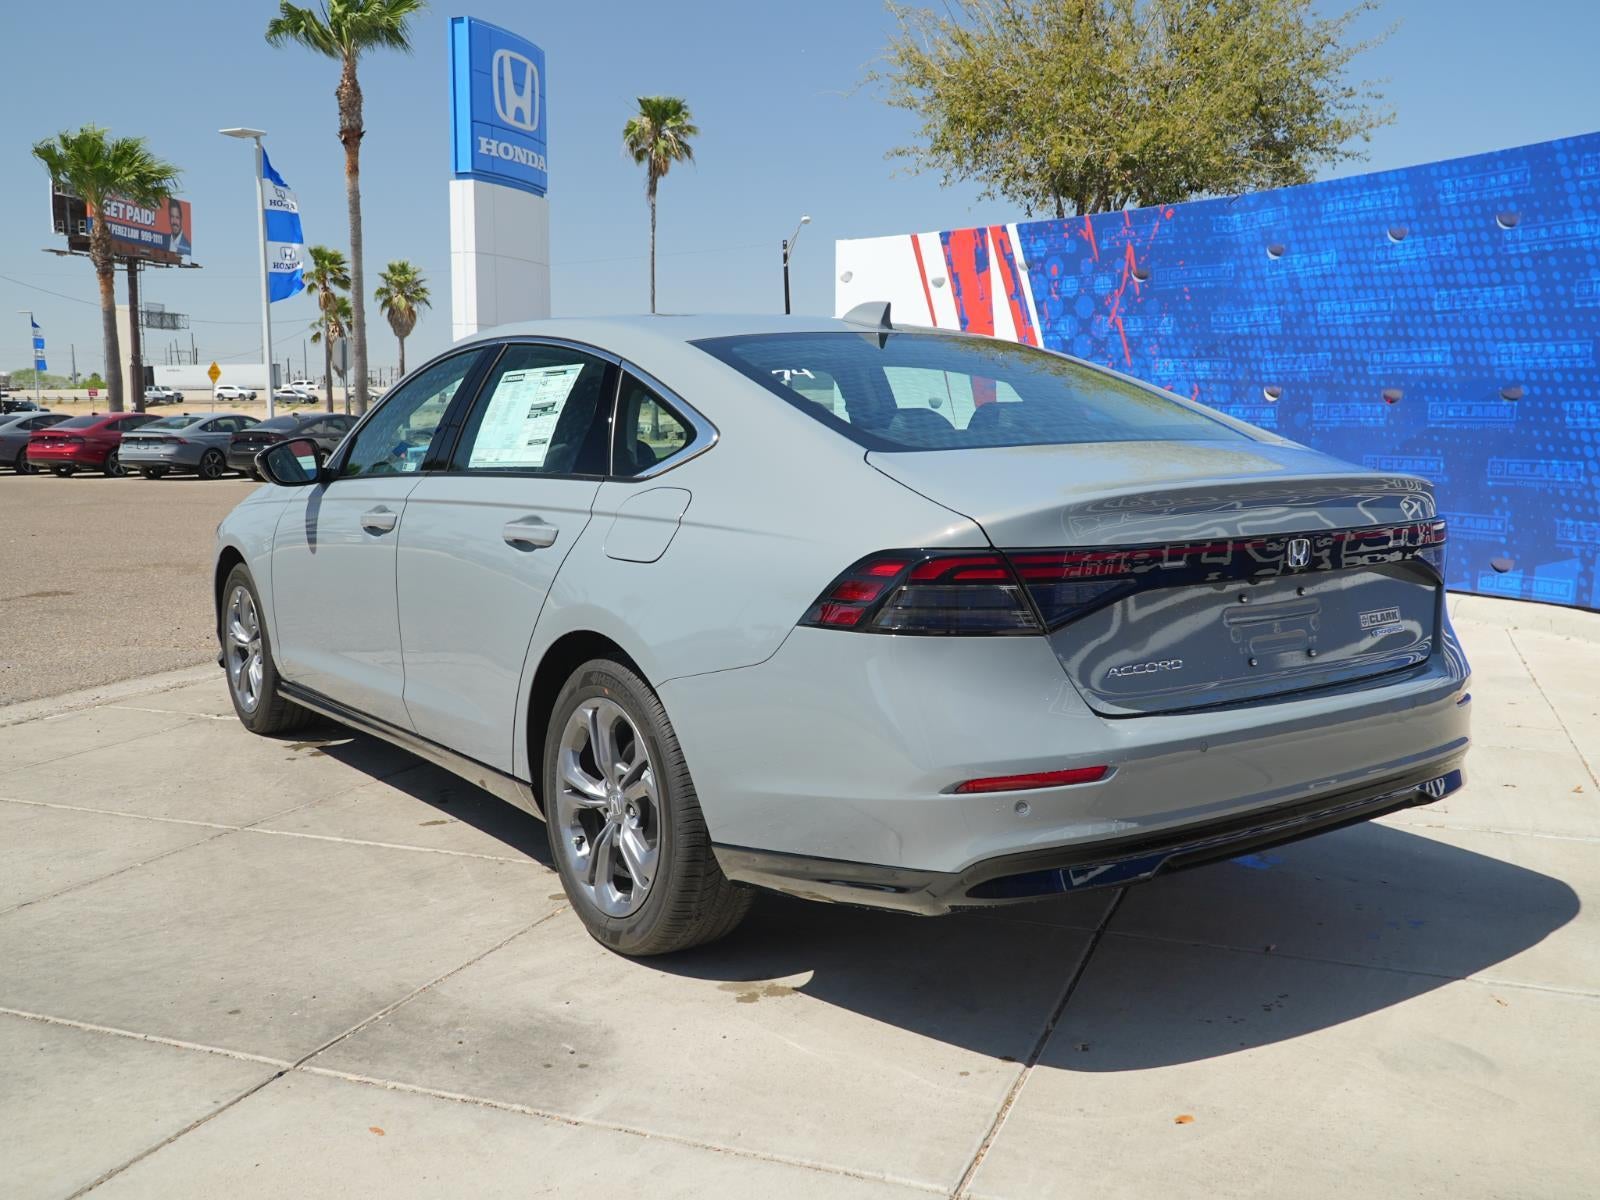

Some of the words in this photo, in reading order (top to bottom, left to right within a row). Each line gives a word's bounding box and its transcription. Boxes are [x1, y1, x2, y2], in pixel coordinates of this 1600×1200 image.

[478, 136, 548, 172] HONDA
[103, 200, 125, 219] GET
[126, 204, 156, 226] PAID!
[1369, 610, 1398, 624] CLARK
[1106, 659, 1183, 678] ACCORD
